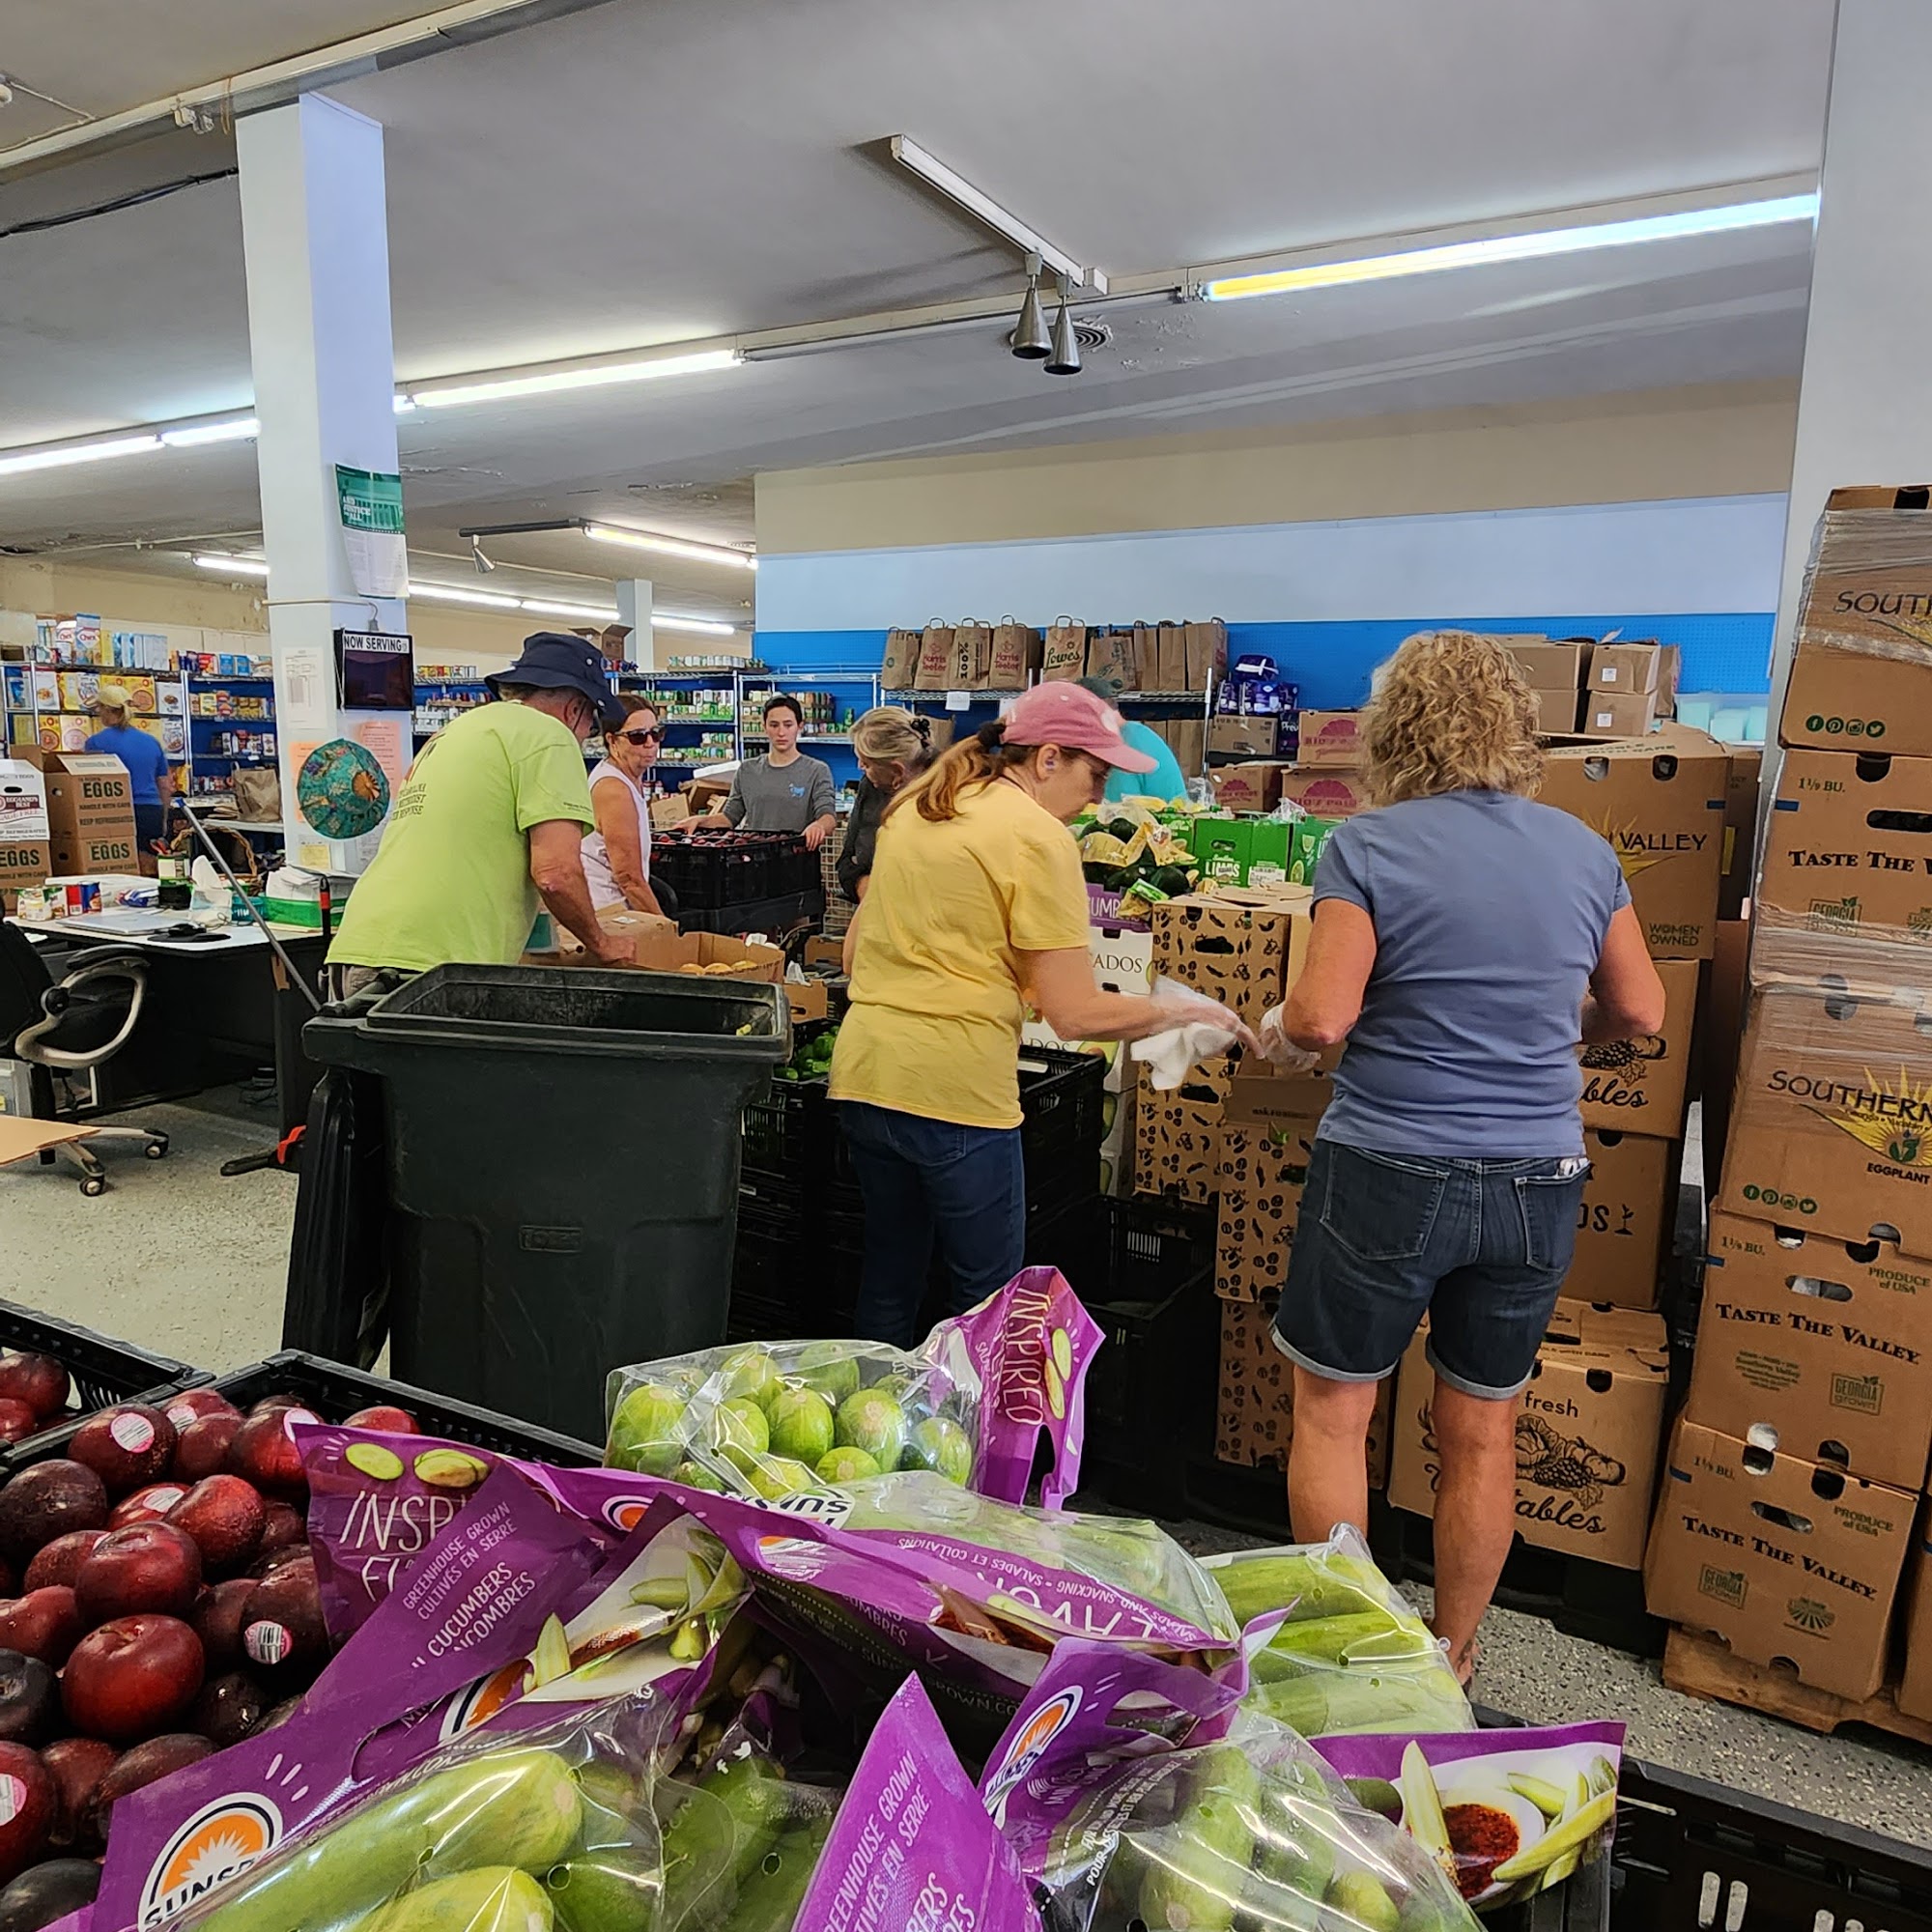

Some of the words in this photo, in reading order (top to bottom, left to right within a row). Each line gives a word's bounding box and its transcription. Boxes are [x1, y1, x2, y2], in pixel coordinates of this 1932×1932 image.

[344, 635, 364, 649] NOW
[366, 638, 402, 652] SERVING
[959, 641, 969, 679] 100%
[994, 661, 1020, 670] Teeter
[996, 652, 1019, 663] Harris
[83, 781, 124, 798] EGGS
[1823, 781, 1846, 793] BU.
[91, 843, 130, 861] EGGS
[1619, 832, 1707, 851] VALLEY
[0, 849, 41, 867] EGGS
[1788, 850, 1859, 867] TASTE
[1867, 851, 1916, 872] THE
[1649, 923, 1700, 936] WOMEN
[1650, 934, 1699, 947] OWNED
[1093, 953, 1143, 974] ADOS
[1767, 1069, 1932, 1122] SOUTHERN
[1866, 1162, 1931, 1184] EGGPLANT
[1744, 1242, 1766, 1256] BU.
[1867, 1266, 1931, 1288] PRODUCE
[1879, 1280, 1892, 1290] of
[1892, 1281, 1917, 1294] USA
[1716, 1303, 1781, 1325] TASTE
[1788, 1312, 1834, 1337] THE
[1839, 1322, 1922, 1365] VALLEY
[1002, 1288, 1052, 1425] INSPIRED
[1835, 1378, 1877, 1401] GEORGIA
[1524, 1390, 1579, 1418] fresh
[1833, 1395, 1877, 1410] grown
[1716, 1464, 1735, 1481] BU.
[1515, 1492, 1606, 1534] ables
[1833, 1505, 1894, 1532] PRODUCE
[1856, 1521, 1879, 1537] USA
[402, 1536, 467, 1610] GREENHOUSE
[466, 1501, 512, 1541] GROWN
[897, 1536, 968, 1561] COLLATIONS
[971, 1551, 987, 1565] ET
[1682, 1516, 1744, 1548] TASTE
[1751, 1536, 1795, 1565] THE
[1801, 1554, 1878, 1602] VALLEY
[416, 1565, 464, 1621] CULTIVÉS
[460, 1548, 480, 1569] EN
[479, 1519, 518, 1552] SERRE
[992, 1556, 1045, 1587] SALADES
[1057, 1579, 1116, 1605] SNACKING
[427, 1561, 513, 1658] CUCUMBERS
[1121, 1599, 1150, 1617] AND
[1151, 1610, 1197, 1642] SALADS
[878, 1749, 919, 1822] GROWN
[881, 1838, 905, 1881] EN
[897, 1784, 931, 1847] SERRE
[1086, 1851, 1108, 1887] POUR
